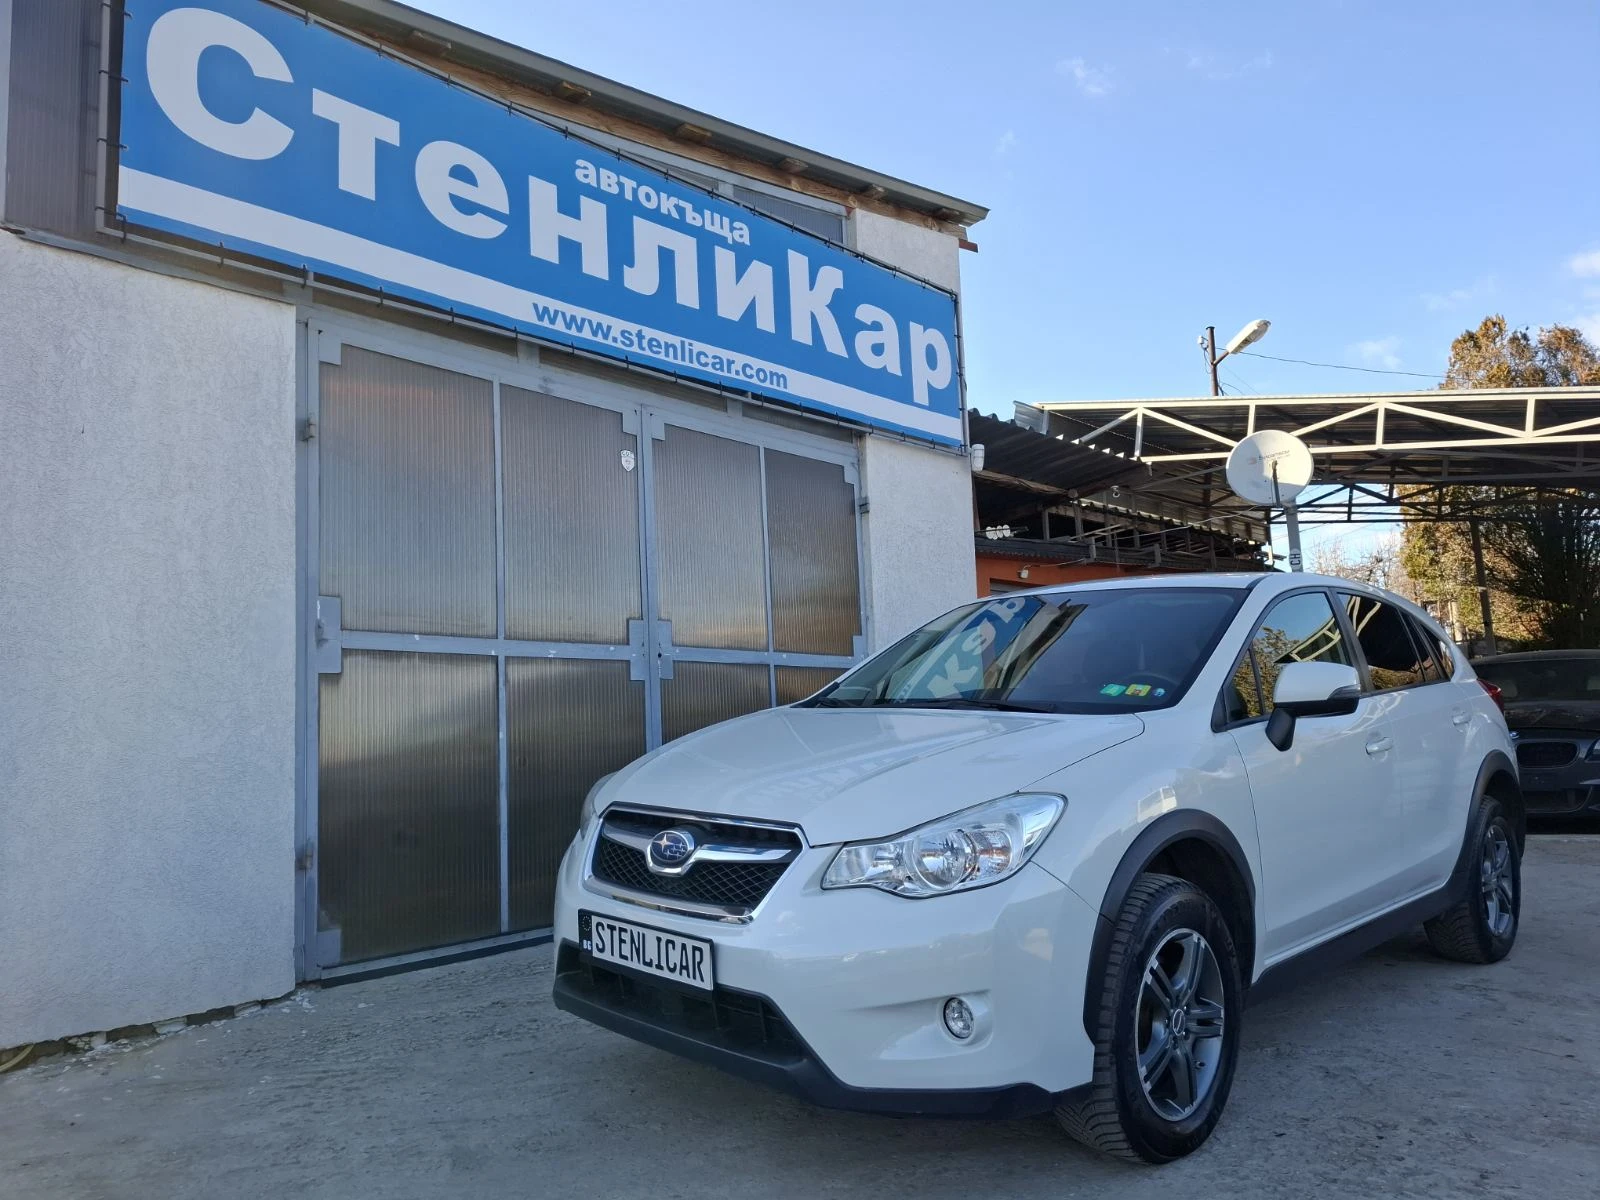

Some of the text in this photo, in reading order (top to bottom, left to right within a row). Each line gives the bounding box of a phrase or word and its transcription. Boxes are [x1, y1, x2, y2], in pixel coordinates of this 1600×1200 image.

[146, 7, 953, 405] СтенлиКар
[576, 158, 750, 245] автокъща
[534, 303, 788, 390] www.stenlicar.com
[595, 921, 705, 982] STENLICAR
